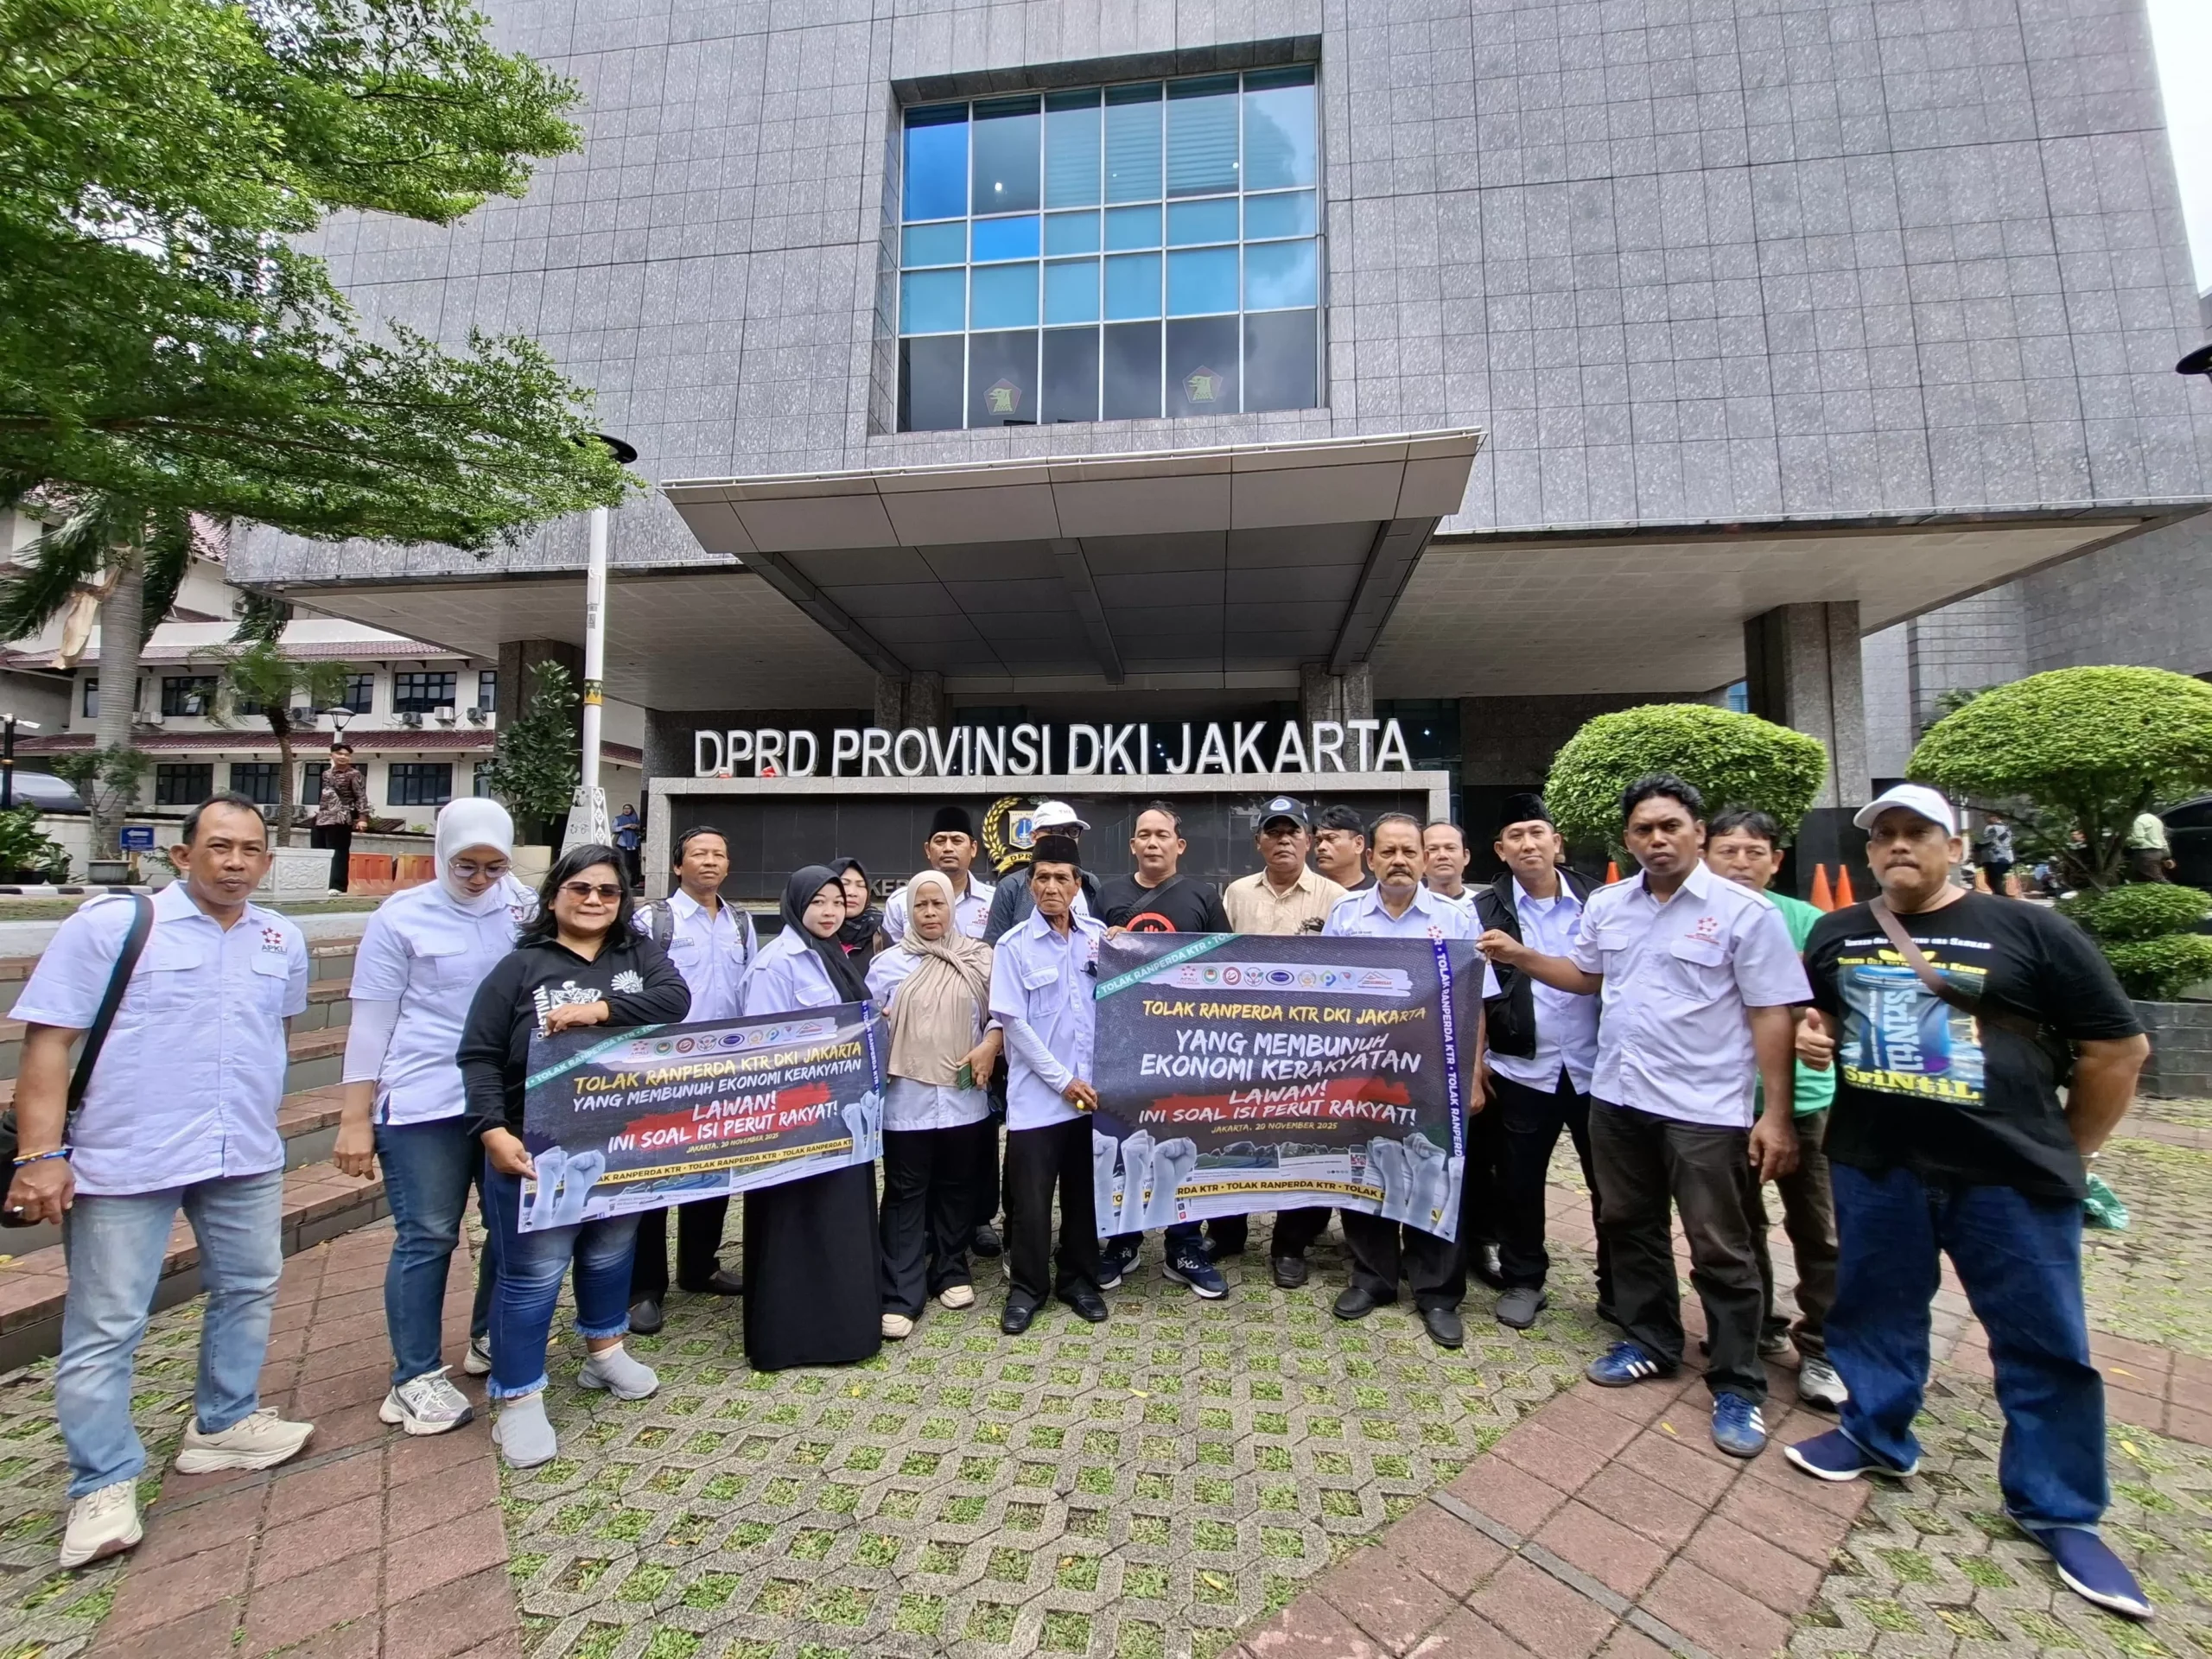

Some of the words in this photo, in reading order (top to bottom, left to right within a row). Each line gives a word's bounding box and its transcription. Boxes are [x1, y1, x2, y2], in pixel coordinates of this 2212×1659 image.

[694, 728, 820, 777] DPRD
[831, 723, 1051, 777] PROVINSI
[1068, 722, 1149, 775] DKI
[1166, 718, 1414, 774] JAKARTA
[1101, 975, 1135, 994] TOLAK
[1134, 952, 1186, 980] RANPERDA
[1185, 942, 1207, 956] KTR
[1436, 953, 1451, 988] TOLAK
[1142, 1000, 1196, 1018] TOLAK
[1198, 1002, 1283, 1022] RANPERDA
[1288, 1006, 1319, 1023] KTR
[1323, 1007, 1351, 1024] DKI
[1356, 1007, 1426, 1026] JAKARTA
[1441, 988, 1454, 1042] RANPERDA
[535, 1064, 569, 1083] TOLAK
[568, 1039, 617, 1067] RANPERDA
[616, 1031, 636, 1045] KTR
[867, 1033, 877, 1071] RANPERDA
[1176, 1029, 1249, 1056] YANG
[1253, 1032, 1390, 1058] MEMBUNUH
[1445, 1044, 1456, 1065] KTR
[573, 1071, 641, 1095] TOLAK
[645, 1059, 735, 1086] RANPERDA
[741, 1052, 769, 1071] KTR
[774, 1051, 798, 1068] DKI
[803, 1040, 861, 1064] JAKARTA
[1140, 1053, 1254, 1081] EKONOMI
[1261, 1049, 1422, 1081] KERAKYATAN
[572, 1093, 624, 1113] YANG
[626, 1082, 714, 1107] MEMBUNUH
[717, 1070, 781, 1093] EKONOMI
[784, 1058, 861, 1082] KERAKYATAN
[1229, 1079, 1328, 1106] LAWAN!
[1447, 1071, 1459, 1107] TOLAK
[691, 1090, 777, 1122] LAWAN!
[1138, 1109, 1167, 1124] INI
[1172, 1107, 1228, 1123] SOAL
[1233, 1105, 1256, 1120] ISI
[1262, 1099, 1325, 1118] PERUT
[1328, 1099, 1417, 1127] RAKYAT!
[607, 1134, 635, 1154] INI
[640, 1126, 692, 1148] SOAL
[697, 1122, 718, 1141] ISI
[723, 1113, 777, 1136] PERUT
[779, 1100, 838, 1128] RAKYAT!
[730, 1135, 764, 1147] NOVEMBER
[765, 1132, 779, 1141] 2025
[1255, 1122, 1267, 1131] 20
[1268, 1121, 1315, 1130] NOVEMBER
[1450, 1108, 1462, 1157] RANPERD
[613, 1167, 663, 1180] RANPERDA
[688, 1160, 716, 1171] TOLAK
[717, 1154, 760, 1166] RANPERDA
[782, 1147, 805, 1157] TOLAK
[806, 1141, 842, 1154] RANPERDA
[1199, 1185, 1218, 1193] KTR
[1227, 1180, 1258, 1191] TOLAK
[1260, 1180, 1313, 1189] RANPERDA
[1344, 1184, 1377, 1197] TOLAK
